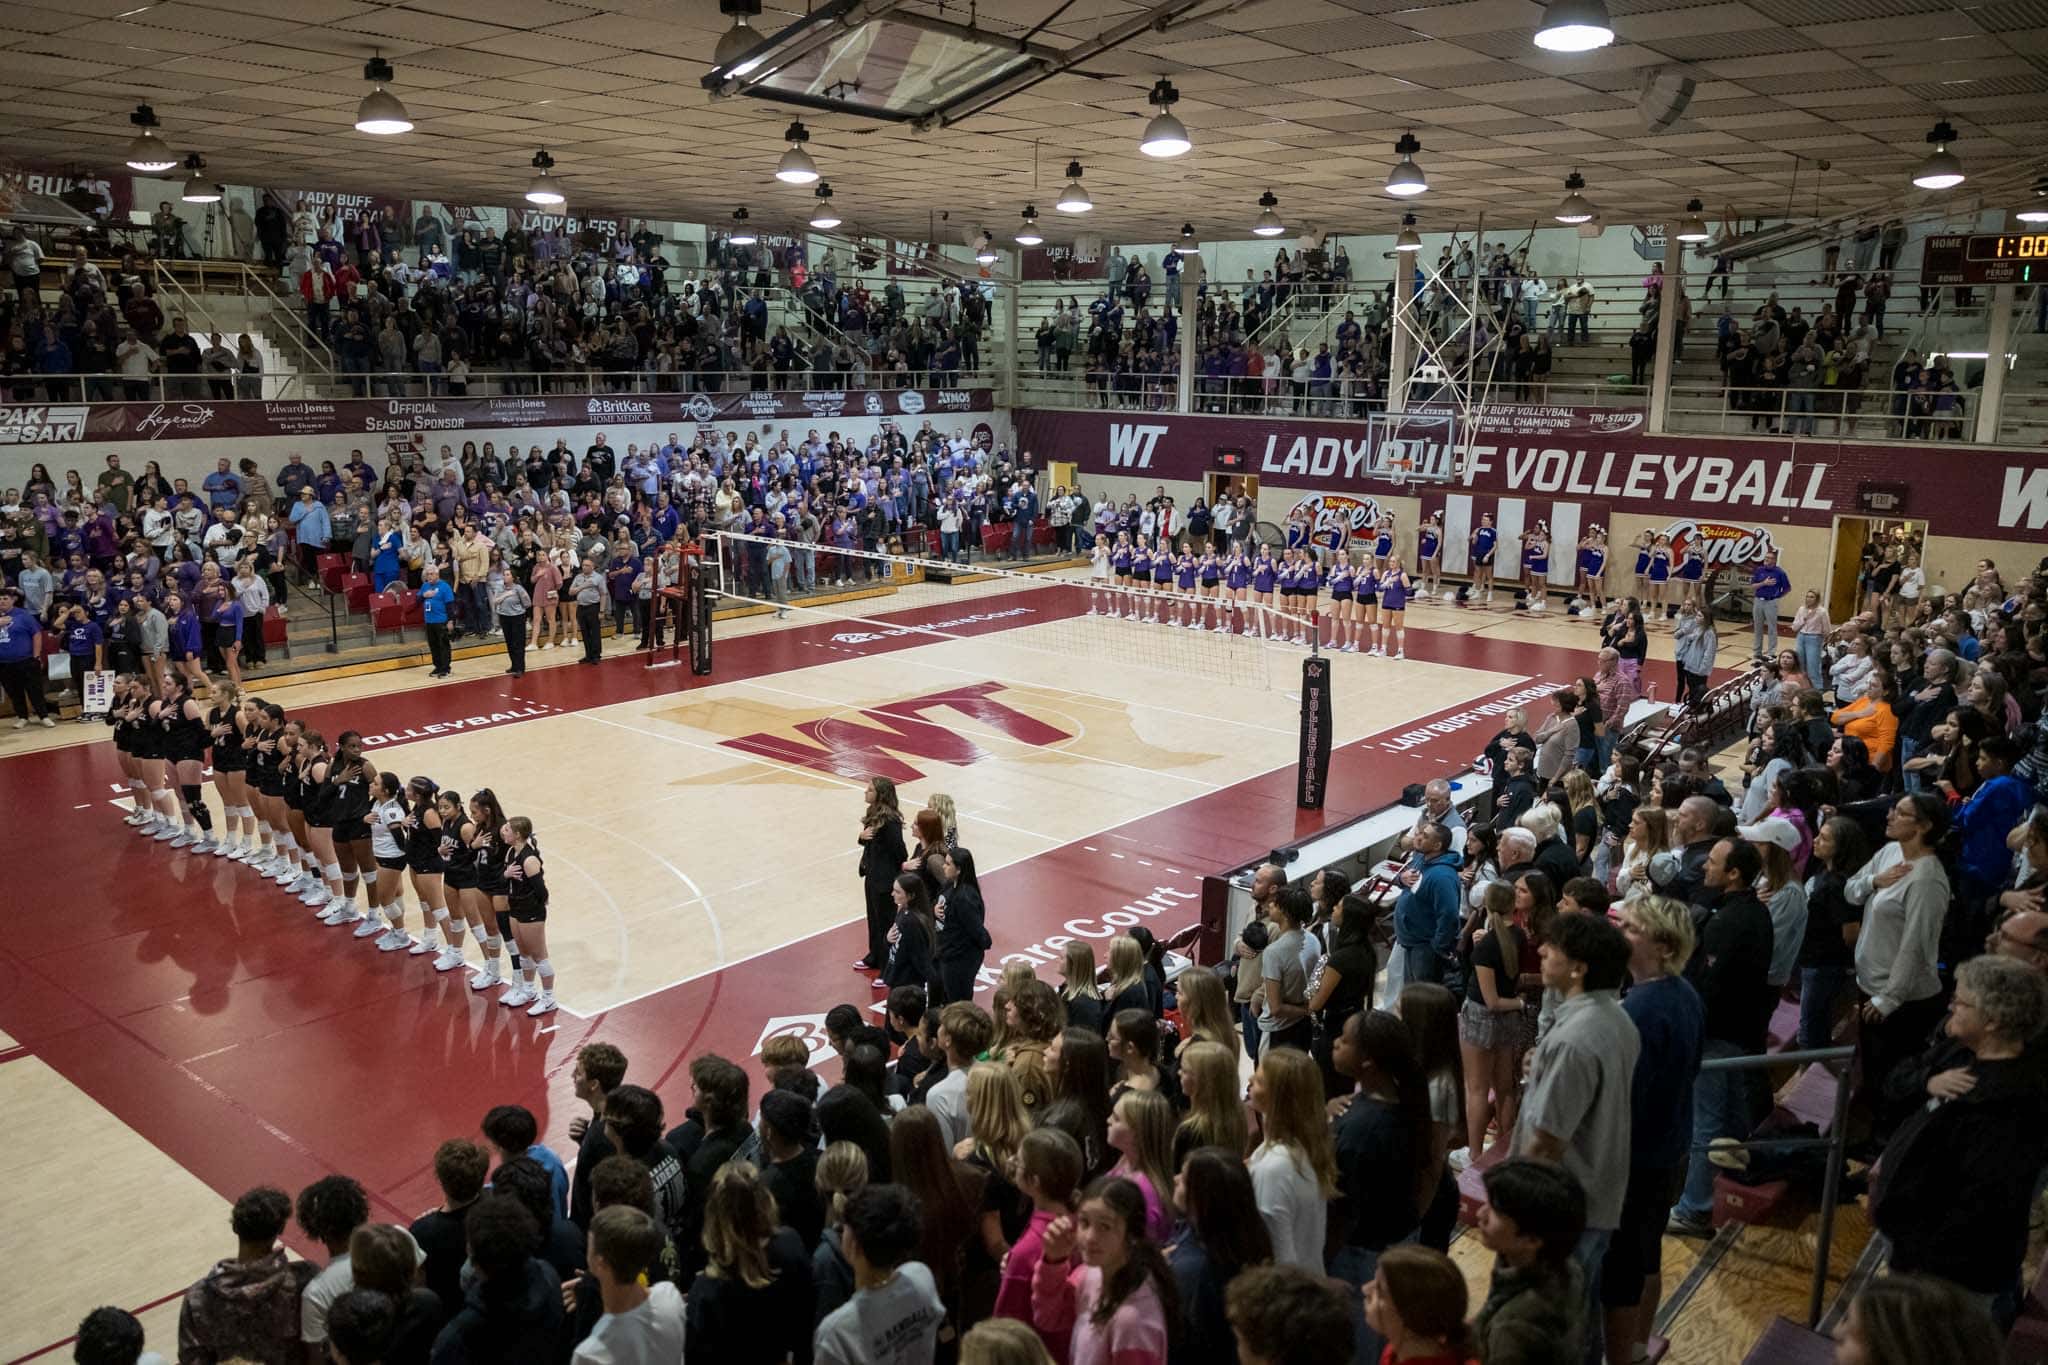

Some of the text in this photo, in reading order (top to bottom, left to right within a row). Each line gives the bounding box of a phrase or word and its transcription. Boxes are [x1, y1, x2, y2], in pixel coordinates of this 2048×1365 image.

[337, 193, 374, 208] BUFF
[522, 216, 563, 232] LADY
[1646, 225, 1664, 236] 302
[1932, 236, 2048, 258] HOME 1:00
[265, 403, 336, 414] Edward Jones
[388, 400, 438, 415] OFFICIAL
[521, 399, 546, 409] Jones
[602, 399, 651, 413] BritKare
[1489, 405, 1516, 416] BUFF
[1517, 406, 1575, 418] VOLLEYBALL
[366, 415, 465, 431] SEASON SPONSOR
[590, 413, 653, 424] HOME MEDICAL
[1513, 417, 1571, 428] CHAMPIONS
[1590, 413, 1637, 424] TRI-STATE
[20, 424, 76, 443] SAK
[1109, 423, 1168, 468] WT
[1261, 434, 1367, 479] LADY
[1506, 447, 1834, 510] VOLLEYBALL
[1701, 525, 1742, 538] Raising
[1380, 681, 1572, 751] LADY BUFF VOLLEYBALL
[362, 705, 551, 746] OLLEYBALL
[716, 680, 1074, 785] WT
[1304, 687, 1320, 804] VOLLEYBALL
[338, 784, 347, 800] 7
[1063, 886, 1200, 938] Court
